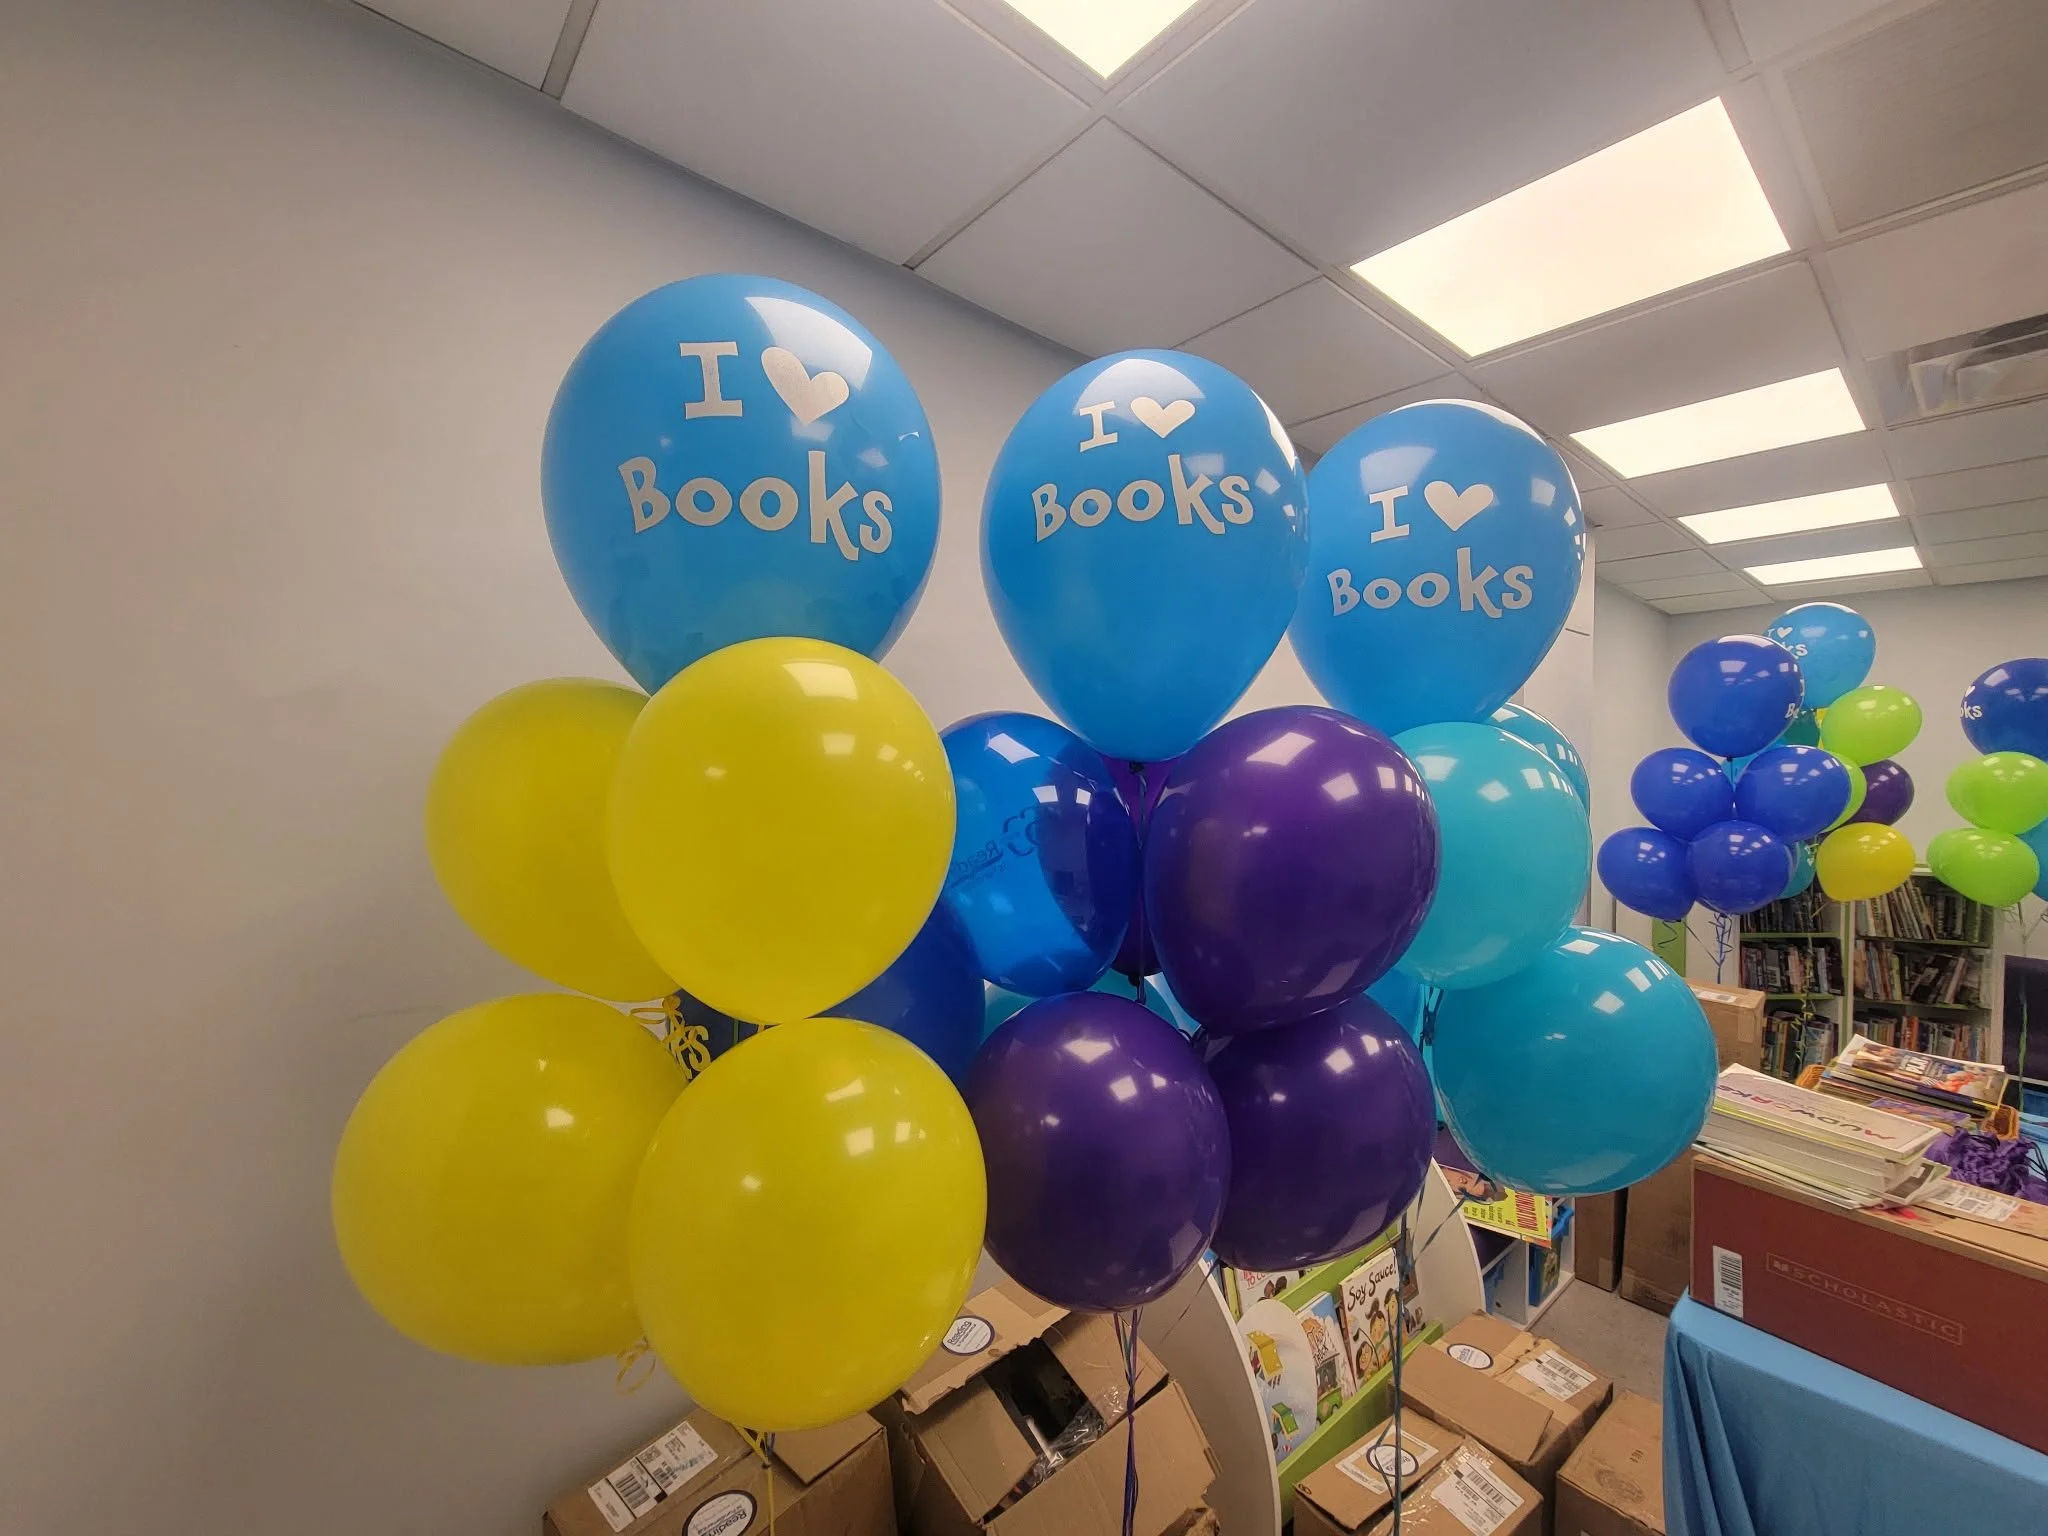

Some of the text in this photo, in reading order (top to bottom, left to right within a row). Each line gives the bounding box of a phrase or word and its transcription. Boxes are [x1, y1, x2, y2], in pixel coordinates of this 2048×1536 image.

[679, 341, 743, 419] I
[1079, 400, 1119, 452] I
[617, 450, 893, 561] Books
[1031, 453, 1254, 544] Books
[1369, 485, 1410, 544] I
[1328, 547, 1534, 619] Books
[1348, 1256, 1397, 1312] Soy Sauce!
[1792, 1267, 1957, 1338] SCHOLASTIC
